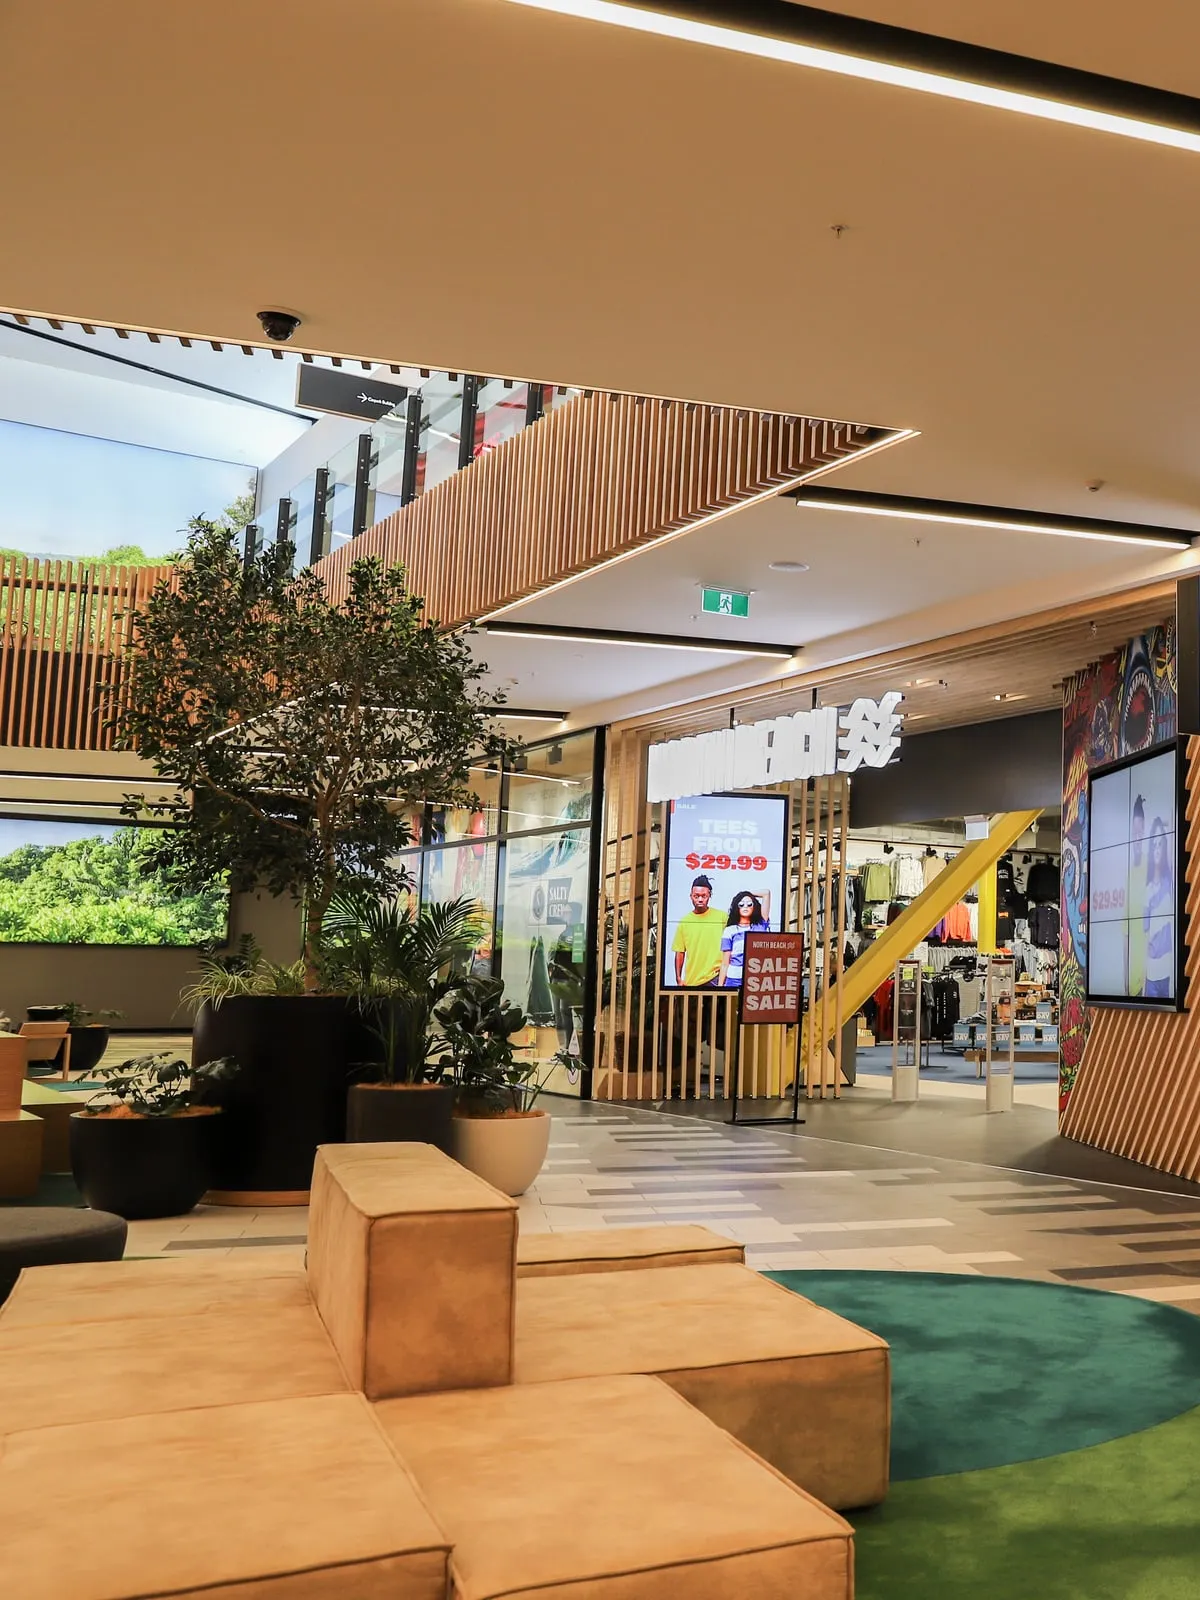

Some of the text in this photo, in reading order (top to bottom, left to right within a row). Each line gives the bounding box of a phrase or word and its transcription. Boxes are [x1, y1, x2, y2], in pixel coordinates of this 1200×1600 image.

[698, 819, 758, 836] TEES
[692, 836, 762, 853] FROM
[685, 852, 768, 871] $29.99
[1093, 888, 1125, 911] $29.99
[752, 941, 787, 949] NORTH BEACH
[748, 957, 798, 973] SALE
[747, 975, 798, 992] SALE
[746, 994, 797, 1011] SALE
